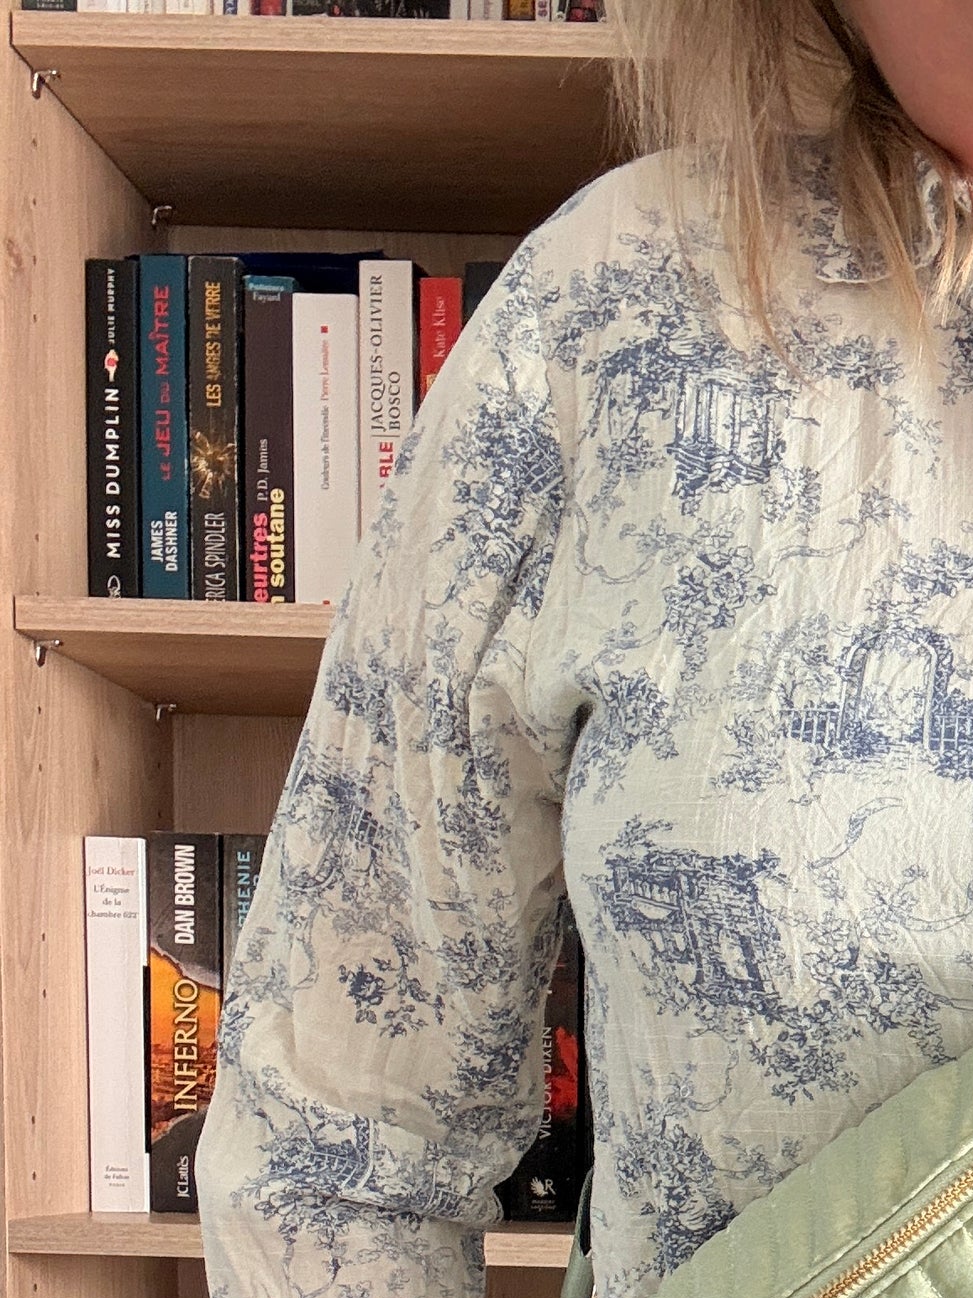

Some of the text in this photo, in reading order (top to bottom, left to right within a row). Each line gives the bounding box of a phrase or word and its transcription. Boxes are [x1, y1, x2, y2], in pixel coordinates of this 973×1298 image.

[107, 268, 116, 344] JULIE MURPHY
[149, 285, 170, 375] MAÎTRE
[432, 295, 446, 358] Kate Klise
[369, 274, 385, 432] JACQUES-OLIVIER
[206, 384, 222, 407] LES
[320, 378, 330, 402] Pierre
[387, 370, 401, 430] BOSCO
[155, 409, 171, 457] JEU
[105, 387, 121, 558] MISS DUMPLIN
[256, 439, 268, 501] P.D. James
[151, 520, 164, 563] JAMES
[165, 511, 178, 572] DASHNER
[204, 512, 225, 568] SPINDLER
[268, 487, 285, 588] soutane
[102, 897, 122, 906] de la
[107, 866, 135, 876] Dicker
[174, 844, 195, 945] DAN BROWN
[174, 980, 199, 1112] INFERNO
